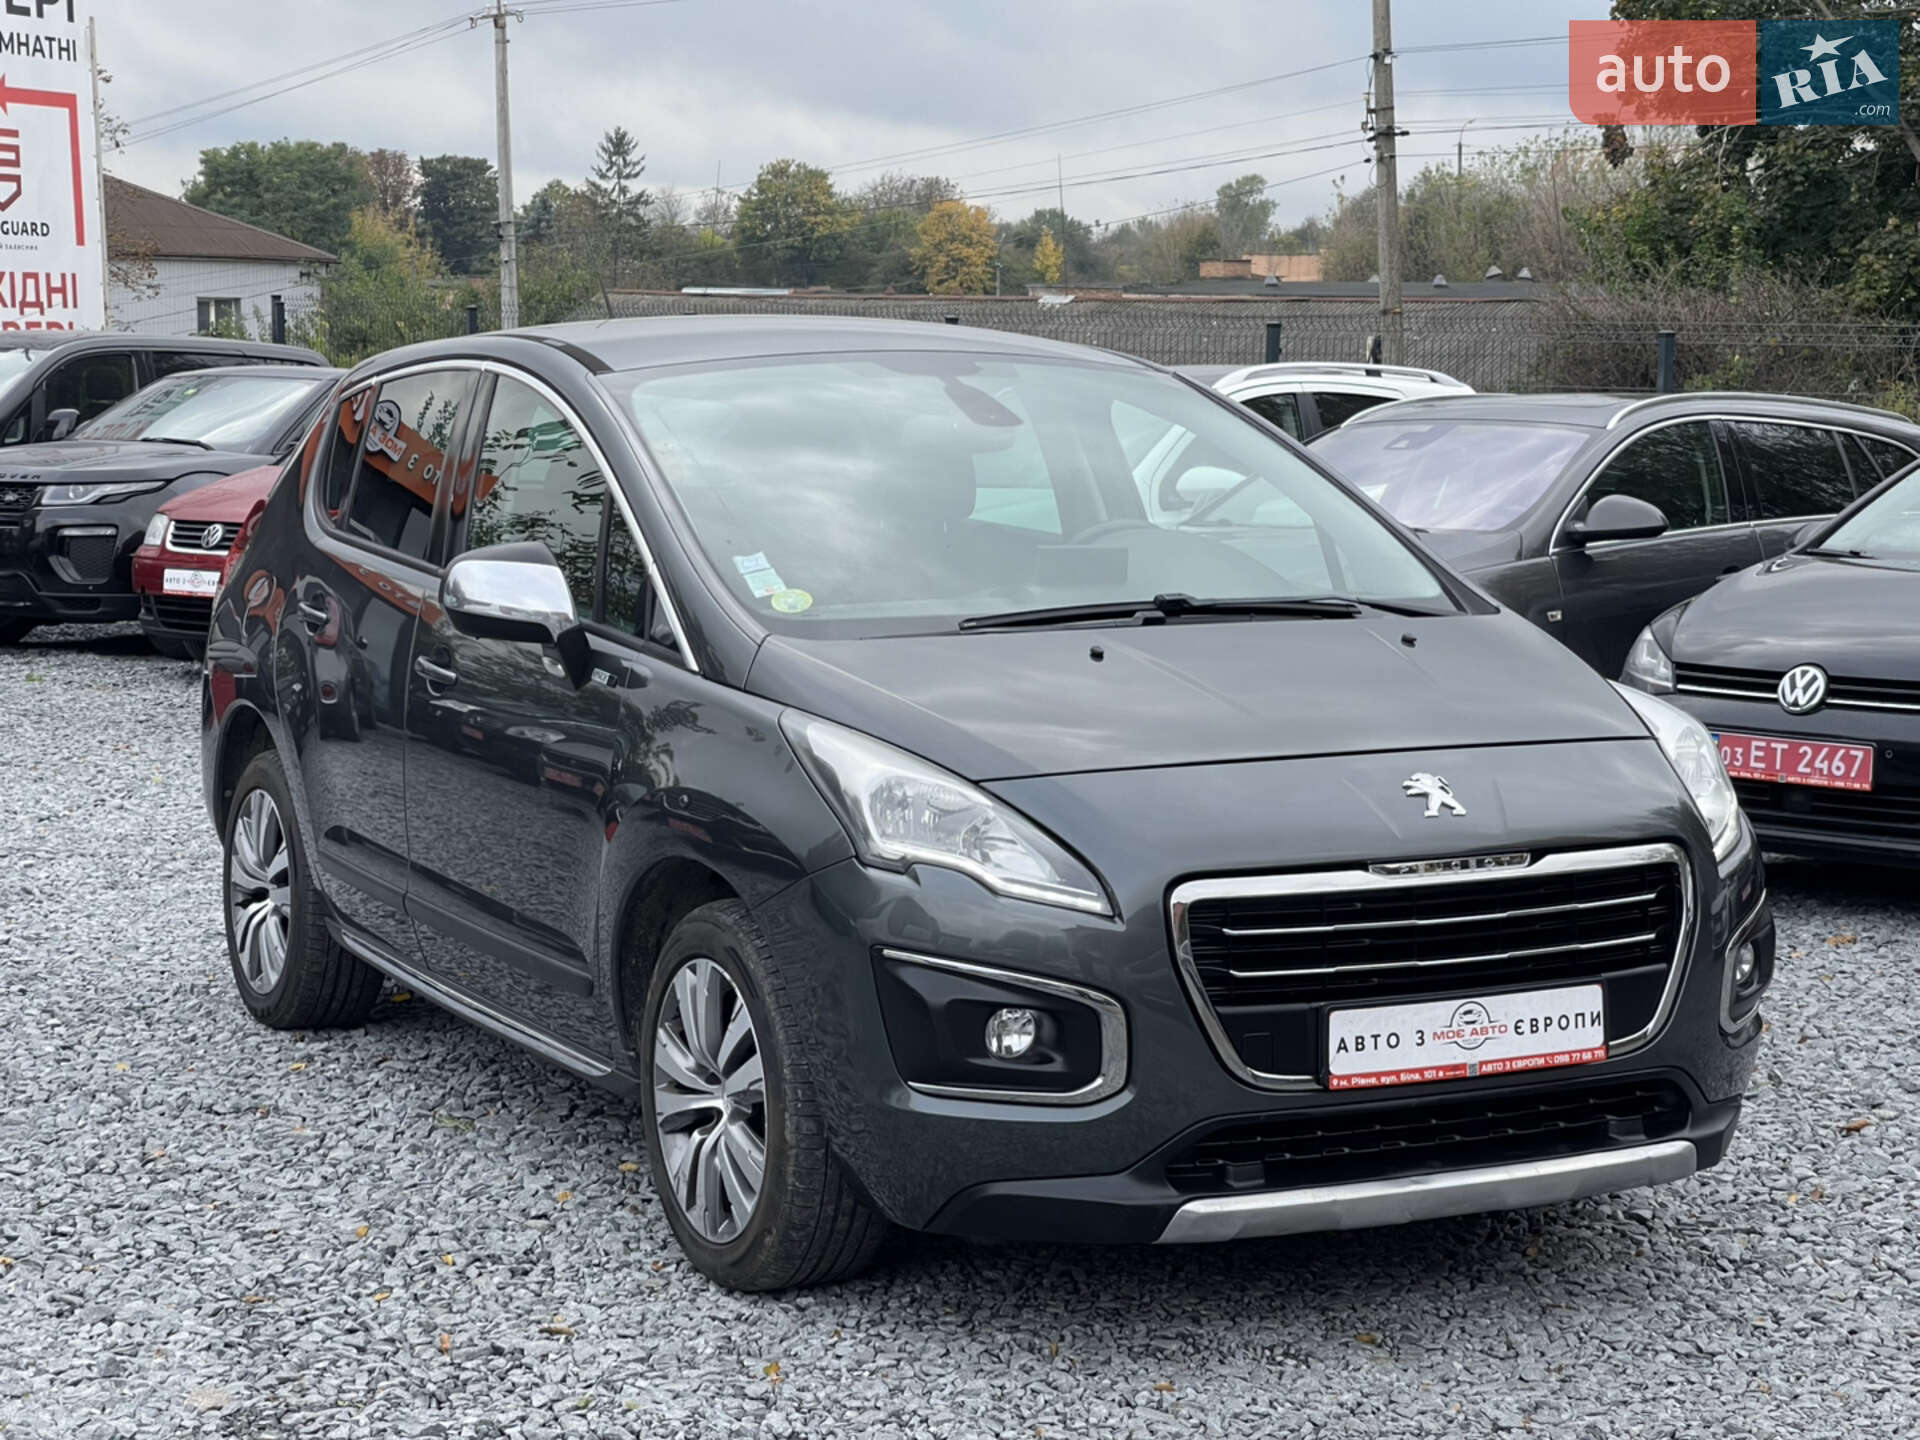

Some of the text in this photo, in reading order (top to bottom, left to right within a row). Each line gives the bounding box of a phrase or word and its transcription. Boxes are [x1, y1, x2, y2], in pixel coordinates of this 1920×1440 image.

[0, 220, 51, 237] GUARD
[1721, 741, 1864, 778] 03 ET 2467
[1432, 1024, 1508, 1041] МОЄ АВТО
[1514, 1010, 1602, 1036] ЄВРОПИ
[1336, 1032, 1401, 1054] АВТО
[1481, 1062, 1502, 1073] АВТО
[1512, 1057, 1545, 1069] ЄВРОПИ
